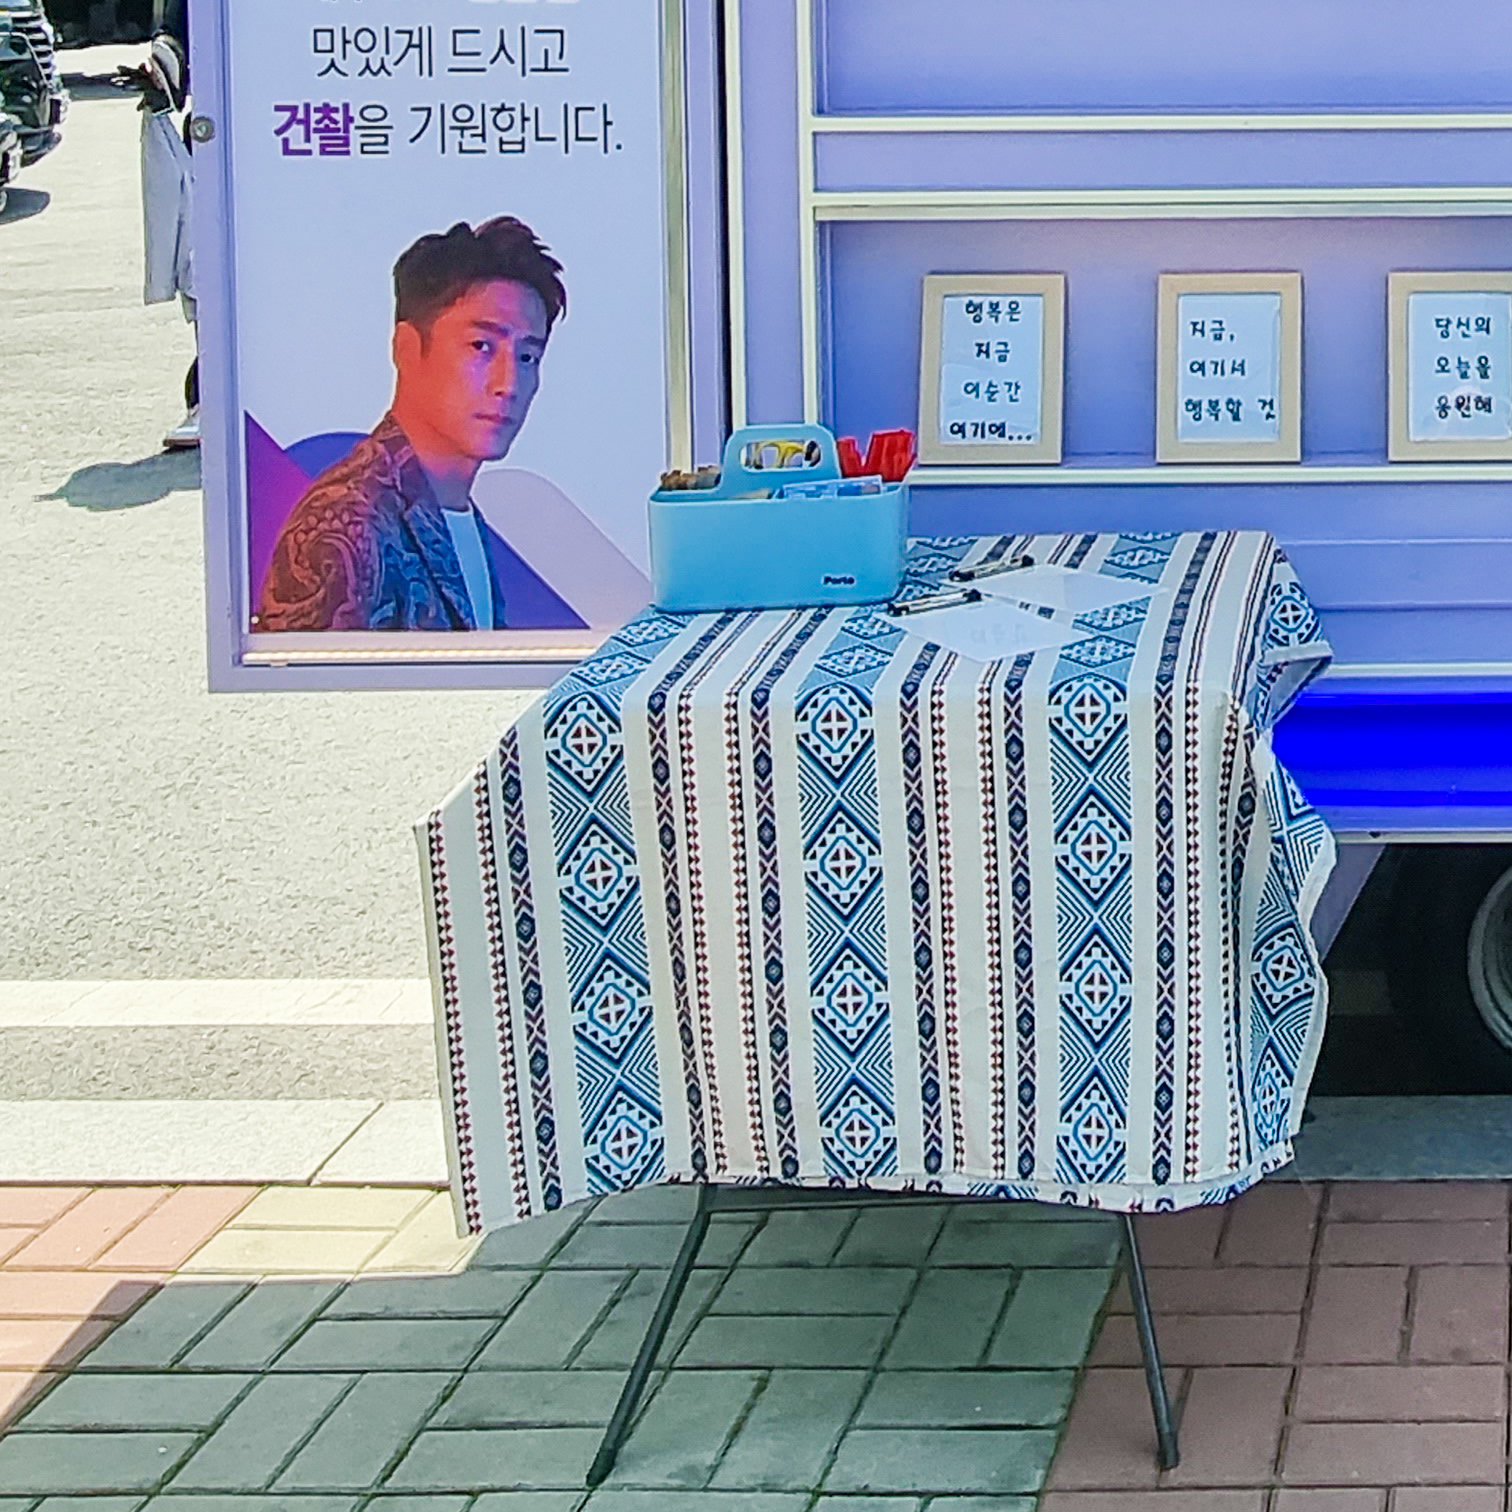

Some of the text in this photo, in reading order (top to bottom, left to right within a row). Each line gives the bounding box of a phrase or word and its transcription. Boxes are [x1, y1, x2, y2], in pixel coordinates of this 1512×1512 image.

[311, 25, 571, 78] 맛있게 드시고
[272, 101, 623, 157] 건촬을 기원합니다.
[964, 299, 1022, 325] 행복은
[1189, 319, 1235, 342] 지금,
[1434, 316, 1492, 340] 당신의
[974, 340, 1011, 364] 지금
[1188, 358, 1247, 378] 여기서
[1434, 354, 1492, 380] 오늘을
[1184, 396, 1277, 423] 행복할 것
[1434, 394, 1493, 420] 응원해
